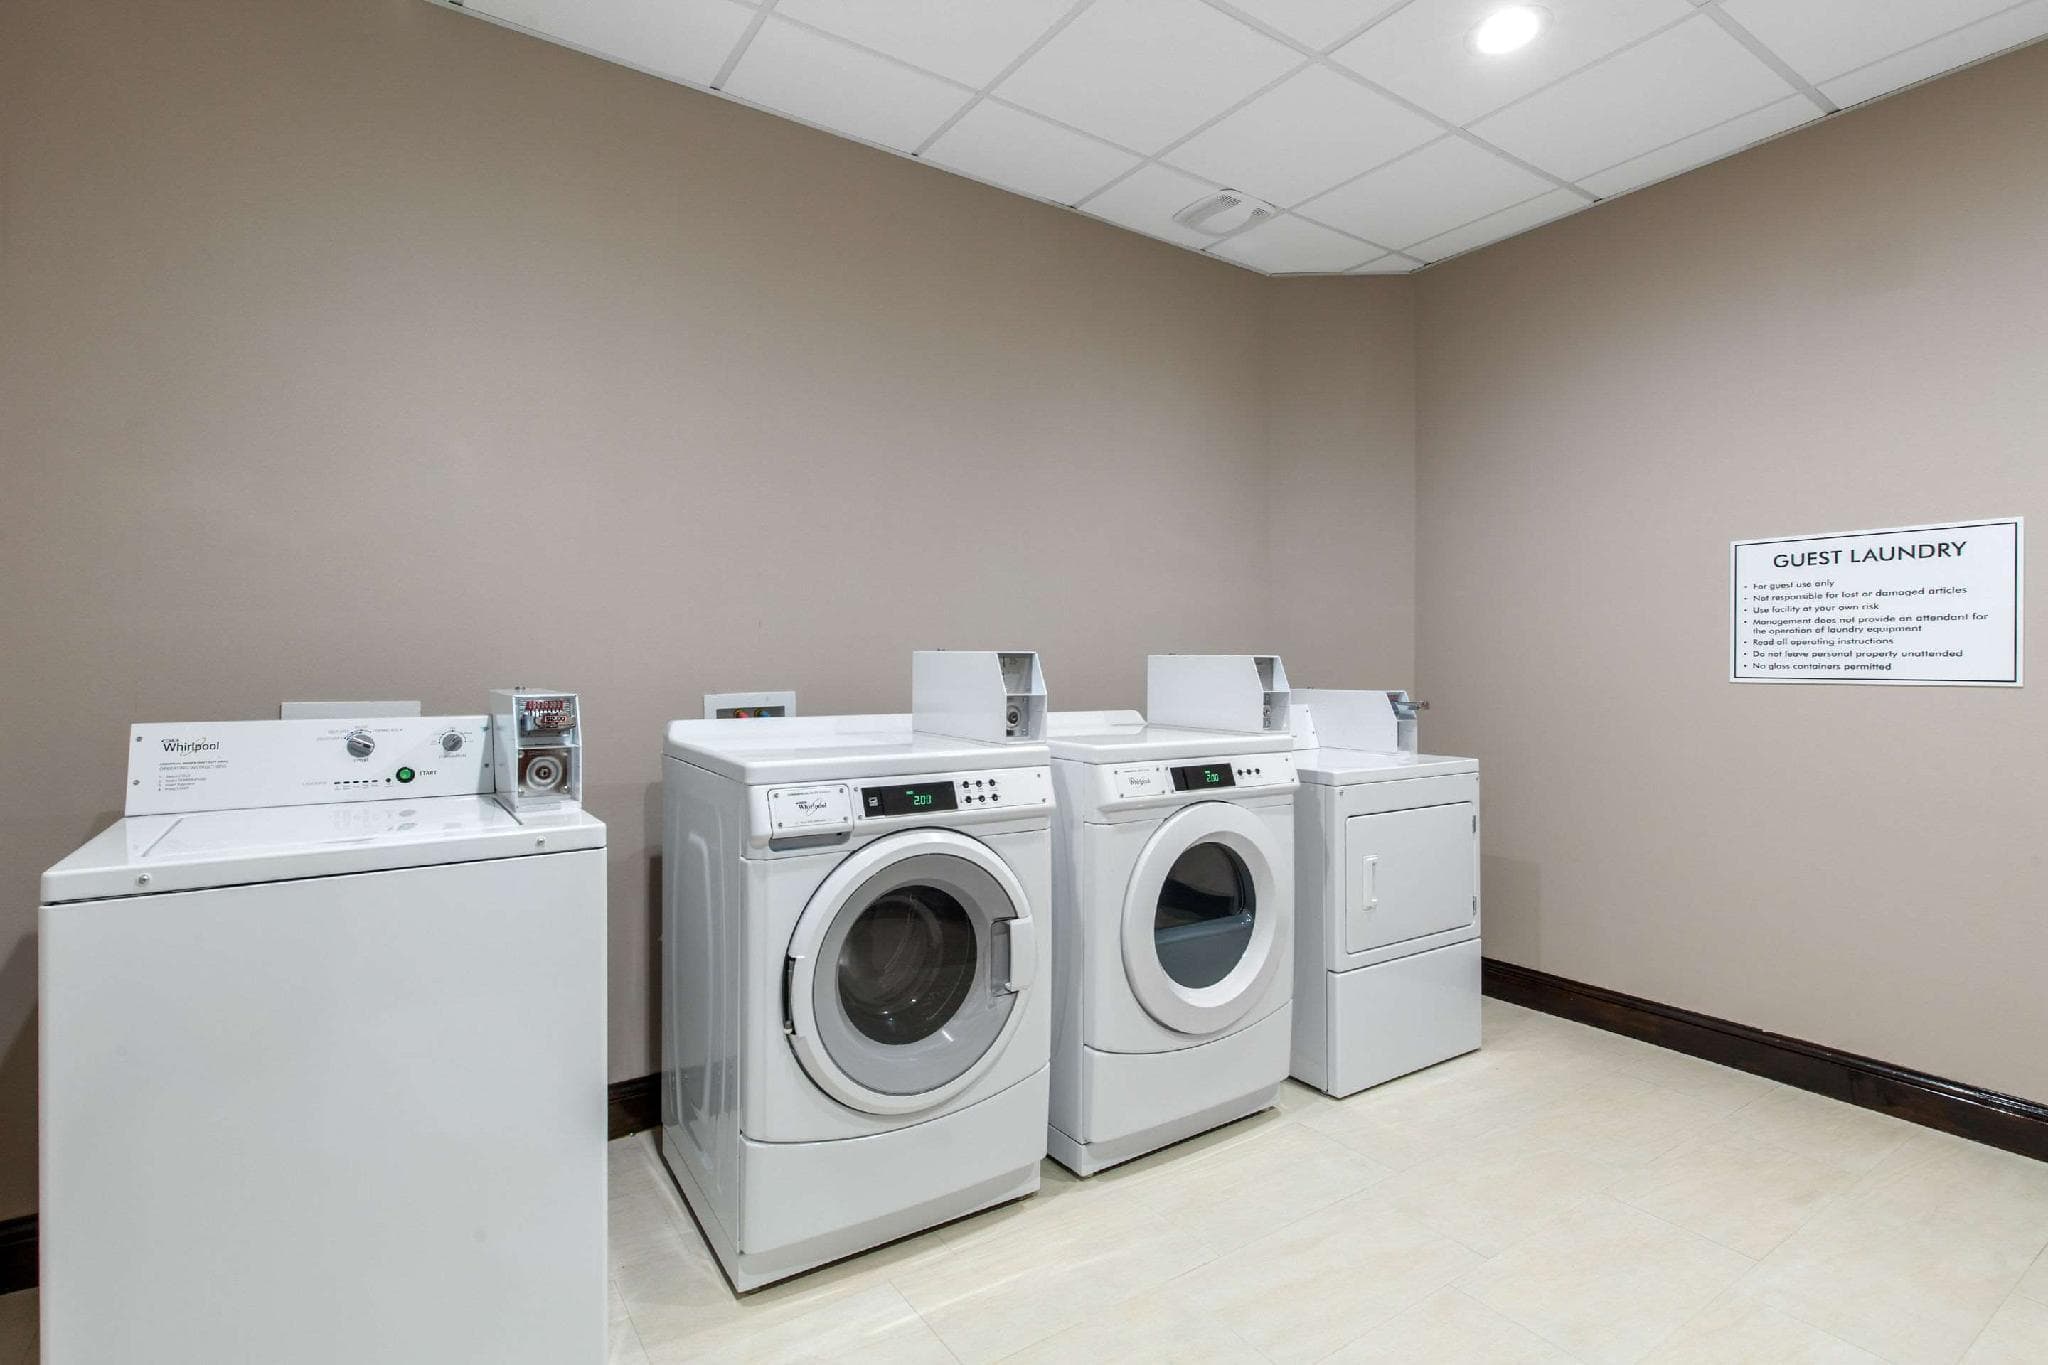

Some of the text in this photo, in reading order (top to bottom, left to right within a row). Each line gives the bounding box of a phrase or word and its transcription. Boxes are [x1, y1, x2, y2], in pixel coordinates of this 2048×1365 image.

[1773, 541, 1967, 568] GUEST LAUNDRY
[1769, 582, 1794, 591] guest
[1814, 579, 1835, 588] only
[1771, 592, 1823, 602] responsible
[1875, 588, 1925, 597] damaged
[1928, 586, 1968, 595] articles
[1772, 605, 1801, 614] facility
[1814, 605, 1836, 613] your
[1753, 618, 1812, 626] Management
[1858, 615, 1896, 623] provide
[1915, 613, 1969, 622] attendant
[1972, 612, 1989, 620] for
[1768, 627, 1812, 637] operation
[1814, 626, 1825, 634] of
[1827, 626, 1864, 635] laundry
[1866, 625, 1922, 634] equipment
[1753, 638, 1775, 646] Read
[1776, 638, 1788, 646] all
[1790, 638, 1835, 647] operating
[1753, 650, 1765, 658] Do
[1784, 650, 1809, 658] leave
[1811, 650, 1853, 658] personal
[1855, 650, 1898, 659] property
[1901, 650, 1964, 658] unattended
[1768, 662, 1790, 671] glass
[1792, 662, 1841, 670] containers
[1844, 662, 1892, 672] permitted
[163, 741, 220, 753] Whirlpool
